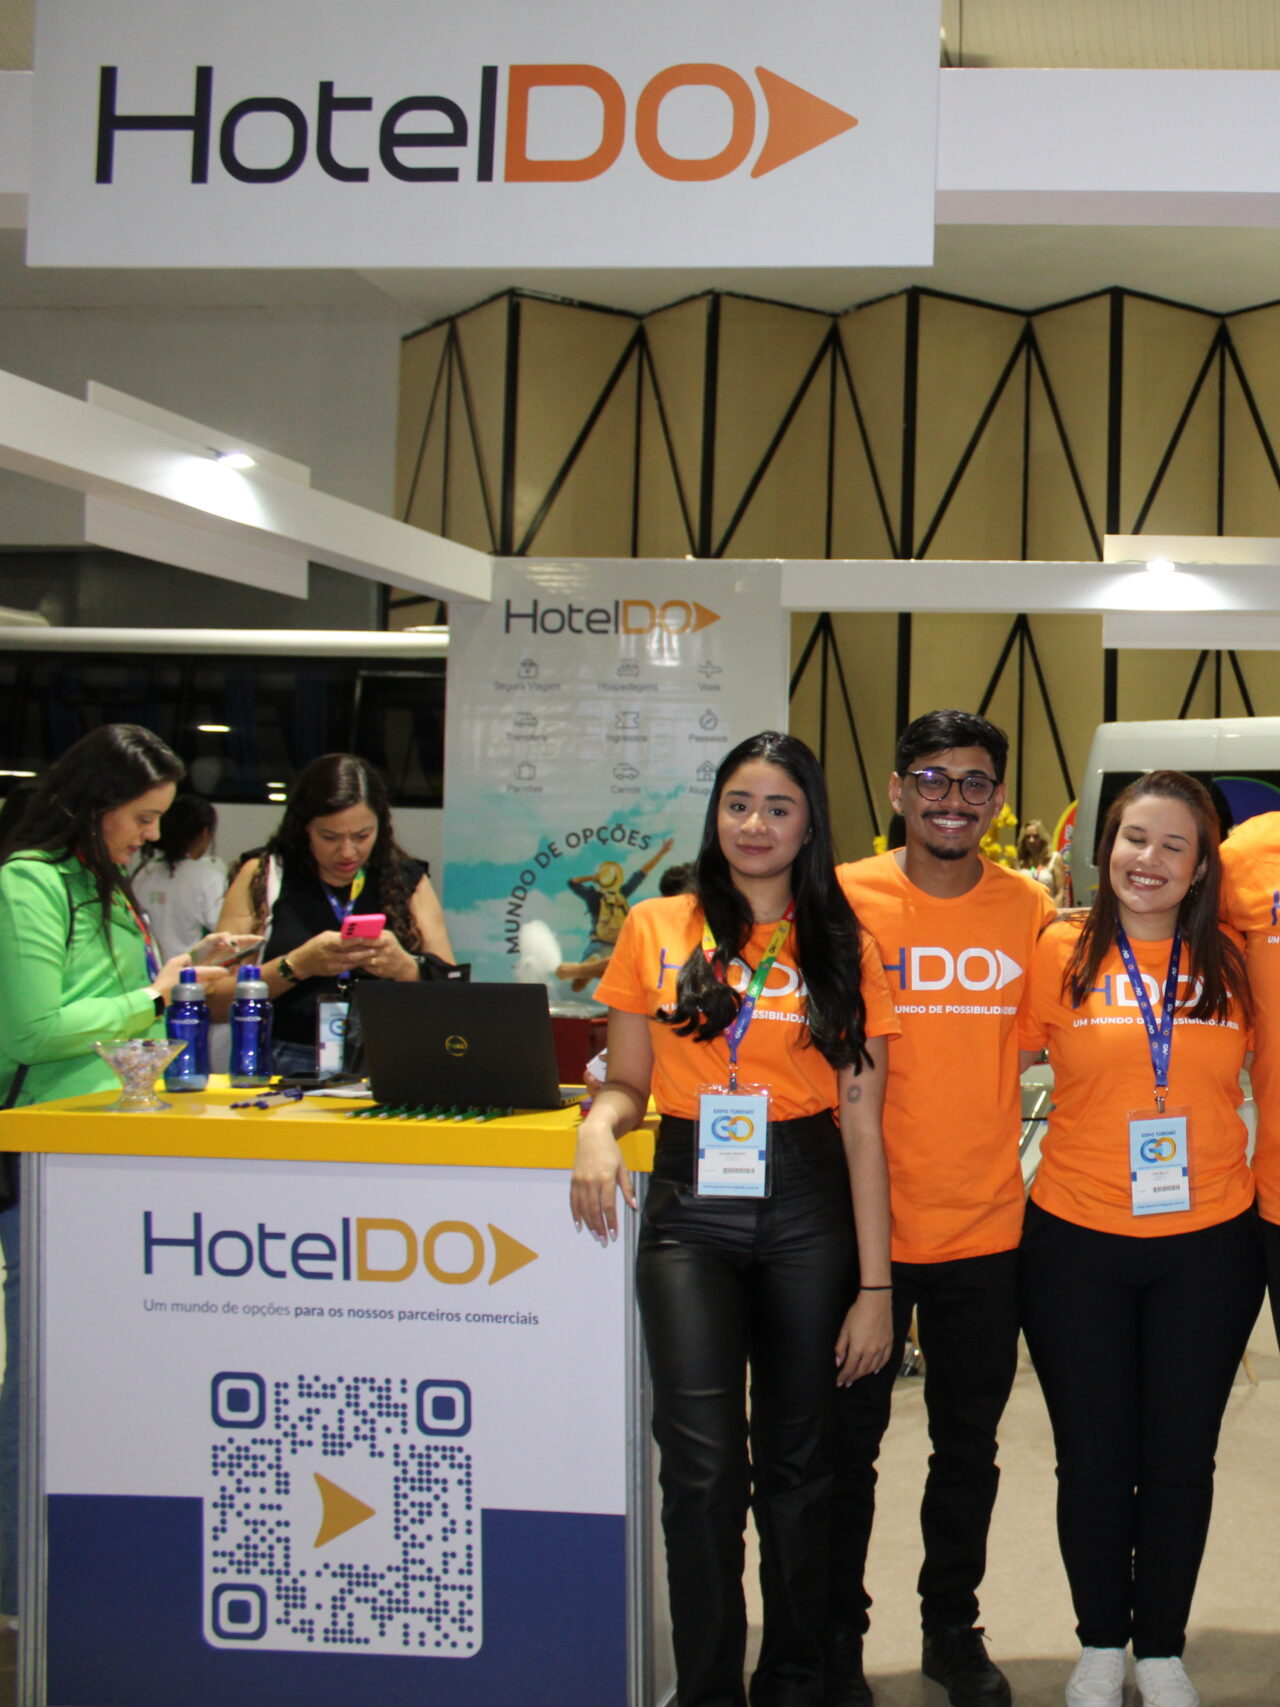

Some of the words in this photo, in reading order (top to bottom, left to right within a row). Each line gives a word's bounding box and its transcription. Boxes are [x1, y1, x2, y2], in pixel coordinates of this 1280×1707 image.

[95, 63, 757, 184] HotelDO
[504, 600, 692, 635] HotelDO
[505, 869, 536, 954] MUNDO
[534, 841, 563, 869] DE
[565, 823, 651, 850] OPÇÕES
[895, 1005, 926, 1014] UNDO
[929, 1005, 942, 1013] DE
[1073, 1019, 1088, 1028] UM
[1091, 1017, 1134, 1025] MUNDO
[143, 1211, 485, 1286] HotelDO
[143, 1299, 167, 1312] Um
[171, 1300, 218, 1314] mundo
[222, 1301, 239, 1314] de
[243, 1301, 291, 1319] opções
[294, 1305, 325, 1319] para
[328, 1306, 344, 1318] os
[348, 1307, 394, 1320] nossos
[398, 1308, 462, 1324] parceiros
[465, 1310, 540, 1325] comerciais
